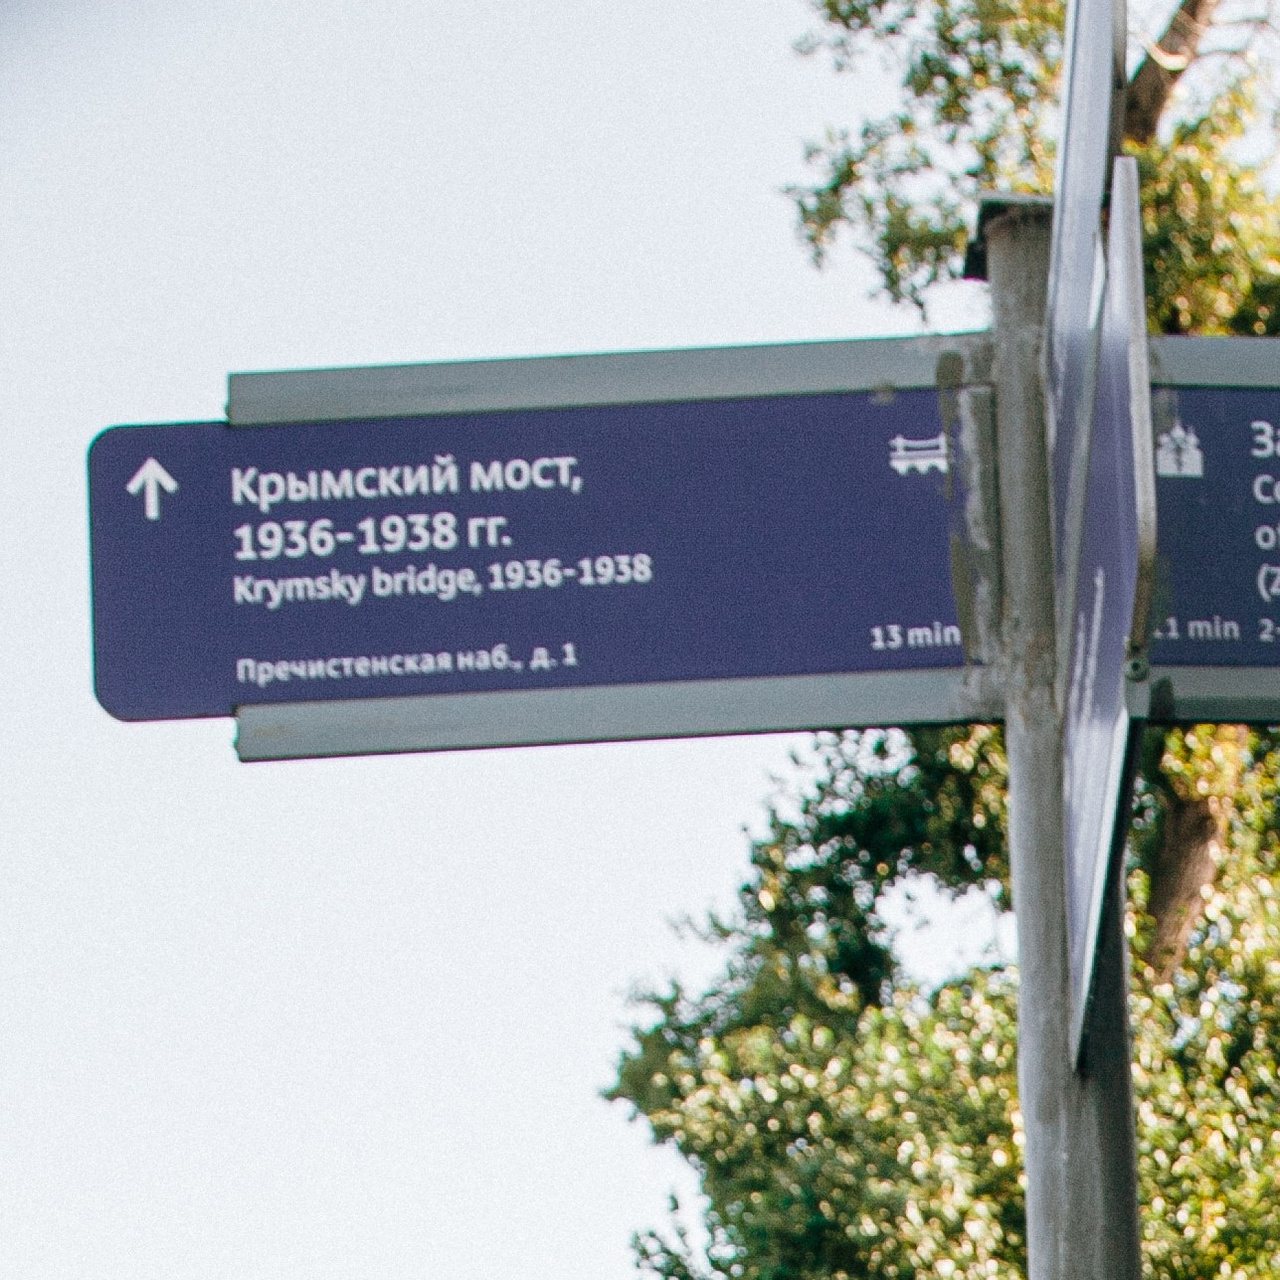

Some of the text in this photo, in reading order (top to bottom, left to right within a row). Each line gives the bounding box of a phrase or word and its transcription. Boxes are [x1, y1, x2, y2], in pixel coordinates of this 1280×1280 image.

[231, 454, 583, 514] Крымский мост,
[234, 511, 513, 561] 1936-1938 гг.
[233, 553, 654, 610] Krymsky bridge, 1936-1938
[870, 621, 961, 651] 13 min
[1188, 615, 1240, 640] min
[236, 651, 453, 688] Пречистенская
[529, 647, 557, 671] д.
[562, 642, 578, 666] 1
